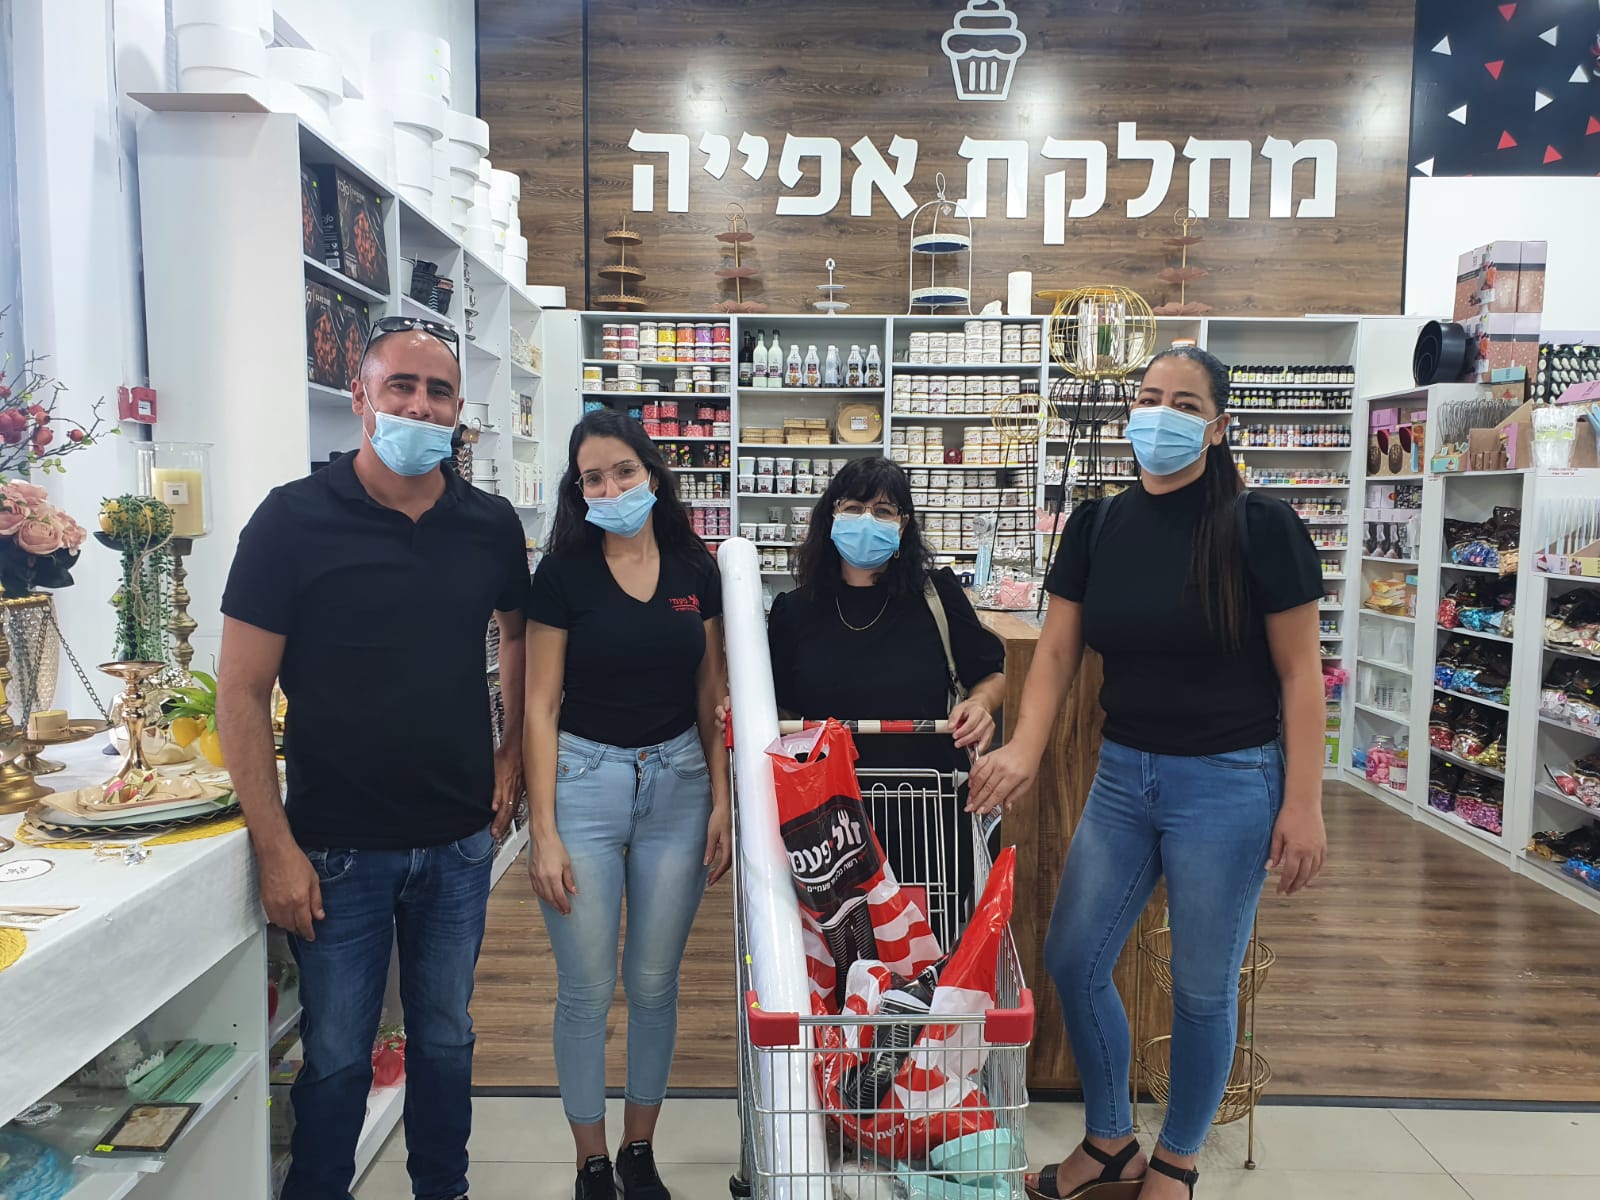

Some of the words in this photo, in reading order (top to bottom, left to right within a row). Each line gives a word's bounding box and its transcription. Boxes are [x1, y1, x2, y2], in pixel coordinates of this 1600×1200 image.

[628, 129, 918, 219] אפייה
[955, 122, 1338, 245] מחלקת
[787, 840, 832, 873] פעמ
